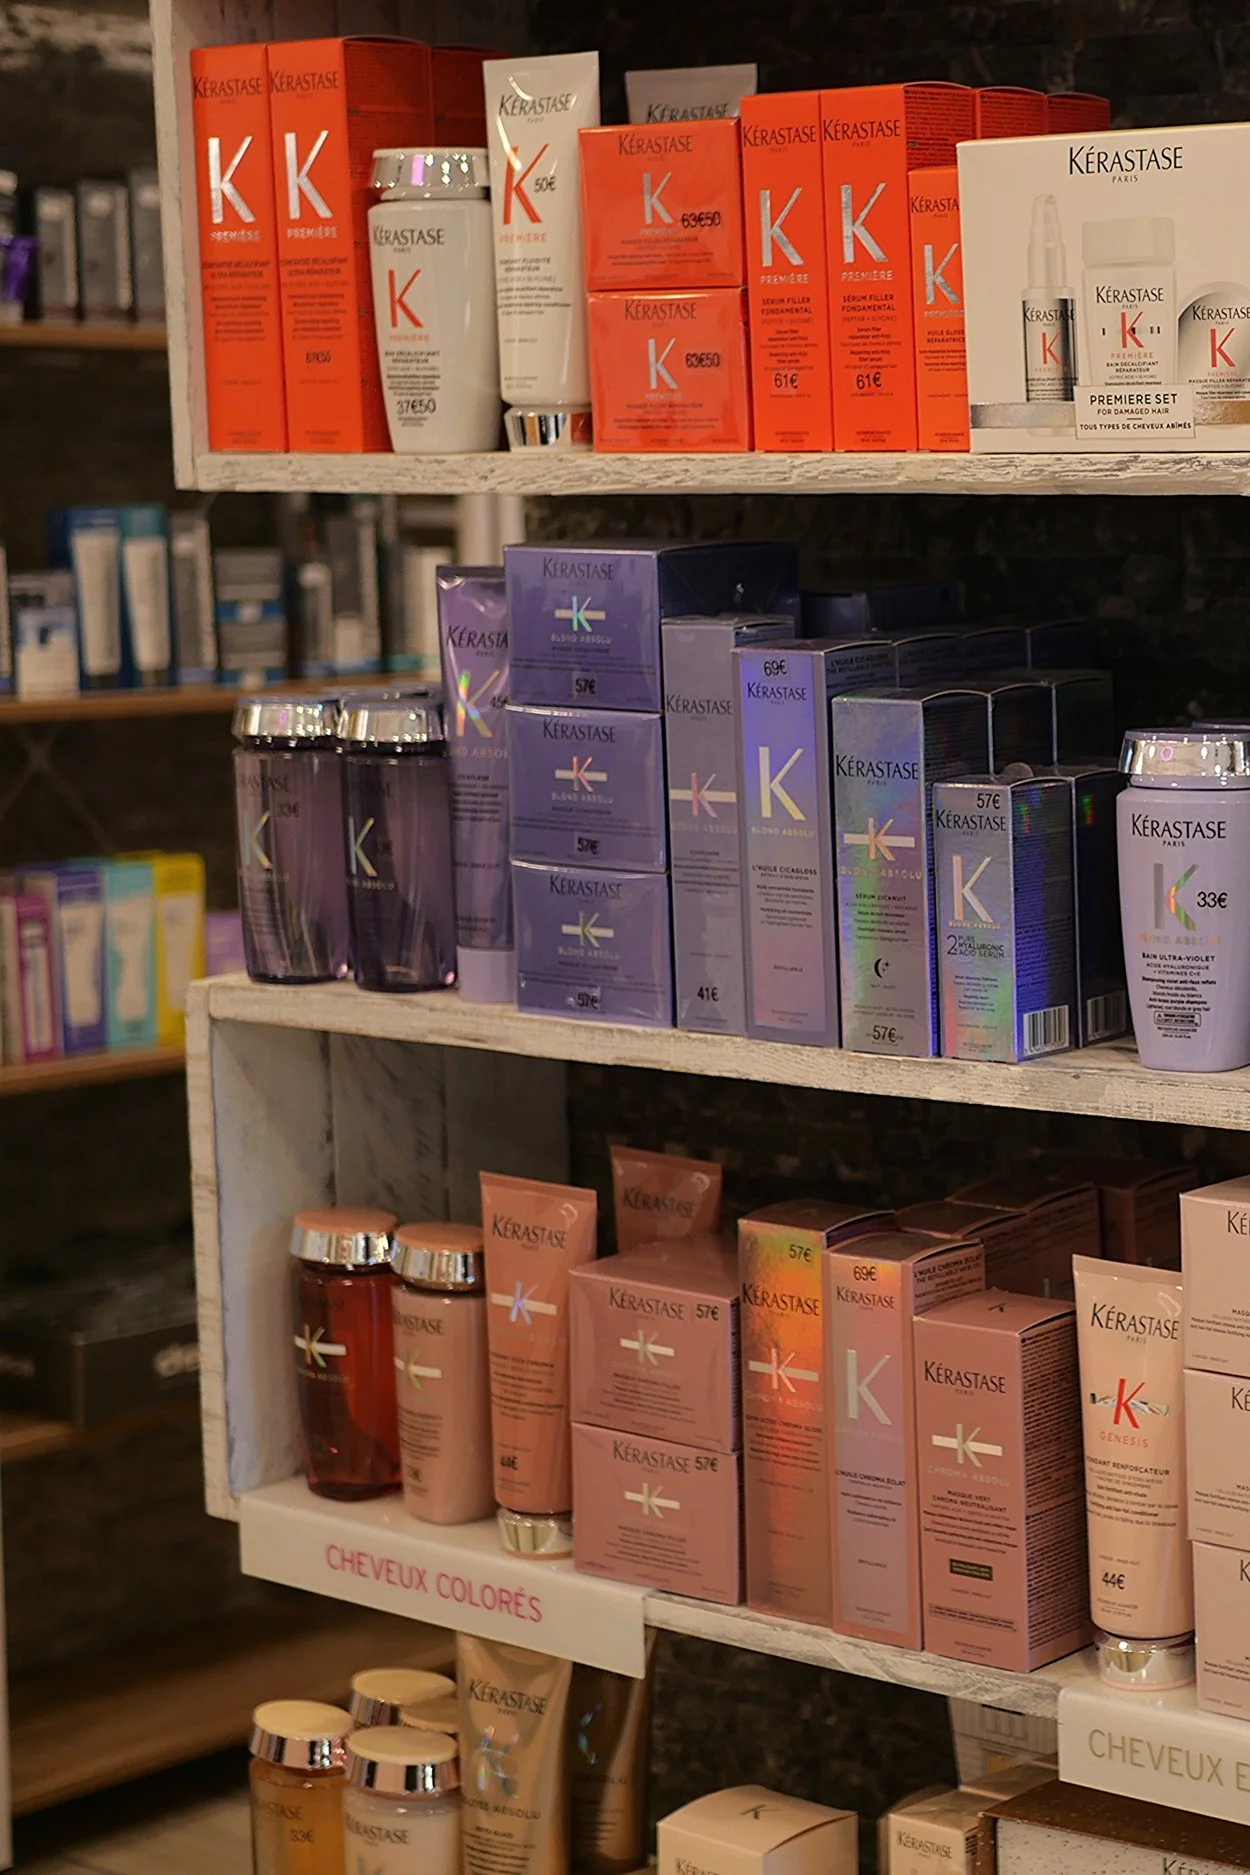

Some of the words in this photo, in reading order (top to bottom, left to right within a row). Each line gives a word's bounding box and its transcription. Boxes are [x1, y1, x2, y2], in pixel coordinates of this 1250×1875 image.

[193, 75, 262, 97] KÉRASTASE
[269, 71, 339, 94] KÉRASTASE
[743, 125, 816, 146] KÉRASTASE
[823, 119, 900, 142] KÉRASTASE
[618, 135, 692, 156] KÉRASTASE
[1069, 146, 1183, 174] KÉRASTASE
[209, 136, 255, 224] K
[534, 176, 556, 192] 50€
[1113, 175, 1138, 183] PARIS
[681, 212, 721, 228] 63€50
[841, 183, 888, 263] K
[373, 228, 444, 247] KÉRASTASE
[869, 294, 893, 303] FILLER
[1096, 286, 1164, 304] KÉRASTASE
[625, 300, 696, 320] KÉRASTASE
[774, 373, 798, 389] 61€
[856, 372, 882, 389] 61€
[1090, 394, 1151, 405] PREMIERE
[1155, 392, 1177, 404] SET
[543, 557, 614, 581] KÉRASTASE
[764, 660, 787, 676] 69€
[575, 678, 596, 694] 57€
[747, 682, 807, 700] KÉRASTASE
[666, 694, 732, 715] KÉRASTASE
[543, 719, 615, 743] KÉRASTASE
[836, 754, 918, 781] KÉRASTASE
[976, 793, 1000, 809] 57€
[936, 809, 1006, 831] KÉRASTASE
[1132, 814, 1226, 839] KÉRASTASE
[576, 837, 599, 854] 57€
[550, 873, 622, 899] KÉRASTASE
[1197, 892, 1228, 908] 33€
[697, 986, 718, 1001] 41€
[873, 1025, 896, 1042] 57€
[789, 1245, 812, 1262] 57€
[853, 1266, 877, 1281] 69€
[609, 1288, 684, 1320] KÉRASTASE
[742, 1283, 820, 1316] KÉRASTASE
[836, 1286, 895, 1309] KÉRASTASE
[696, 1304, 719, 1321] 57€
[1091, 1303, 1179, 1340] KÉRASTASE
[924, 1361, 1006, 1393] KÉRASTASE
[1115, 1378, 1146, 1429] K
[1100, 1431, 1149, 1448] GENESIS
[613, 1441, 690, 1473] KÉRASTASE
[695, 1456, 718, 1472] 57€
[326, 1545, 426, 1592] CHEVEUX
[437, 1571, 541, 1624] COLORÉS
[1102, 1572, 1125, 1589] 44€
[1089, 1728, 1224, 1788] CHEVEUX
